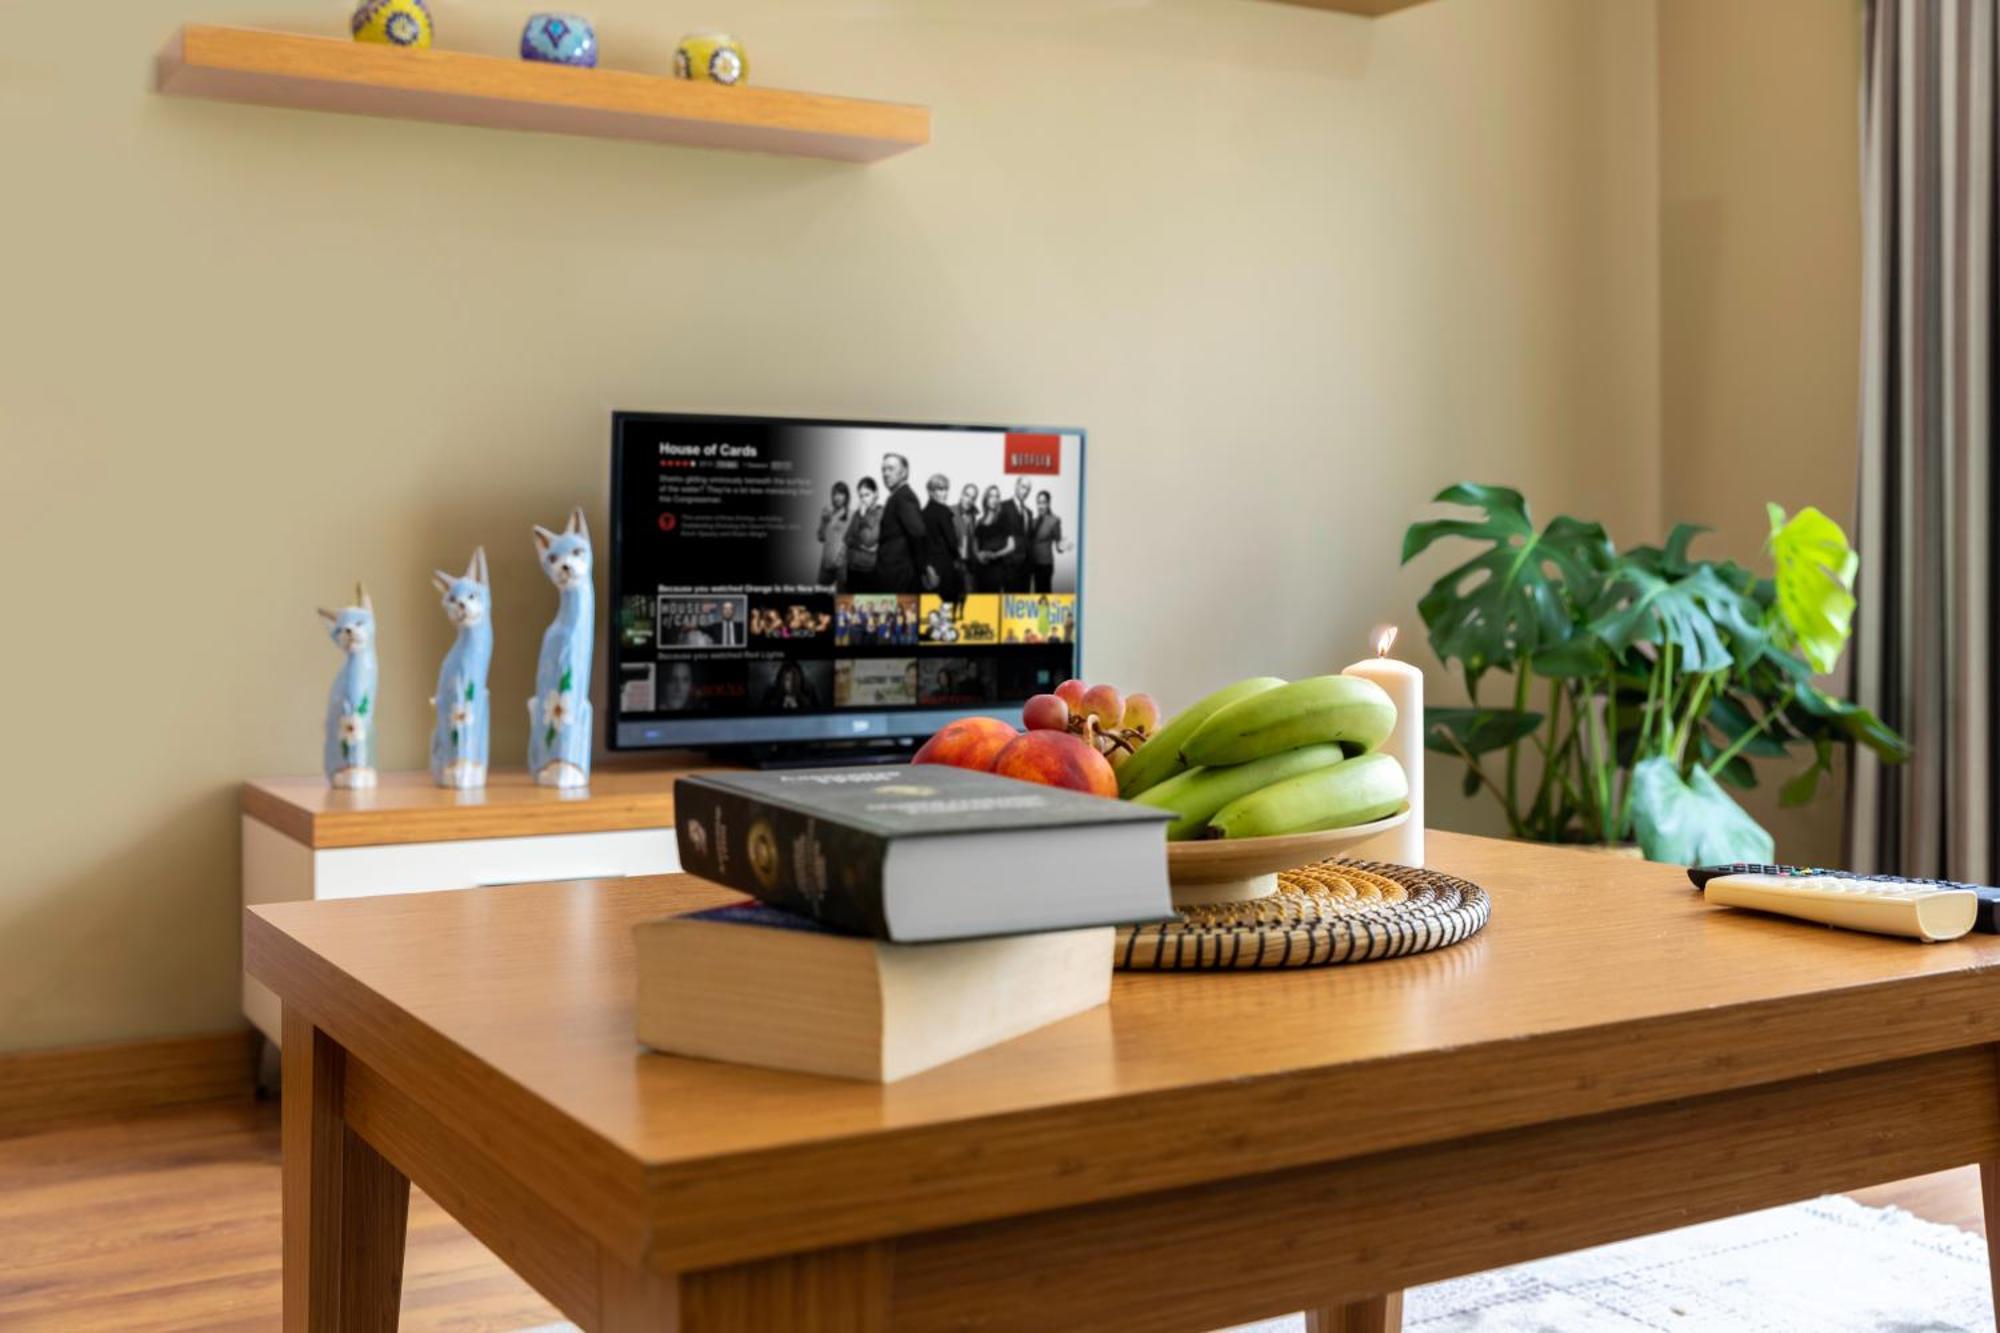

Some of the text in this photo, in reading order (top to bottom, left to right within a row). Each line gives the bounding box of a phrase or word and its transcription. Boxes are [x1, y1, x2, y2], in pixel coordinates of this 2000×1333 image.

[659, 442, 758, 457] House of Cards
[1011, 453, 1051, 467] NETFLIX
[657, 584, 693, 593] Because
[694, 586, 708, 594] you
[710, 584, 743, 593] watched
[1003, 594, 1076, 625] New Girl
